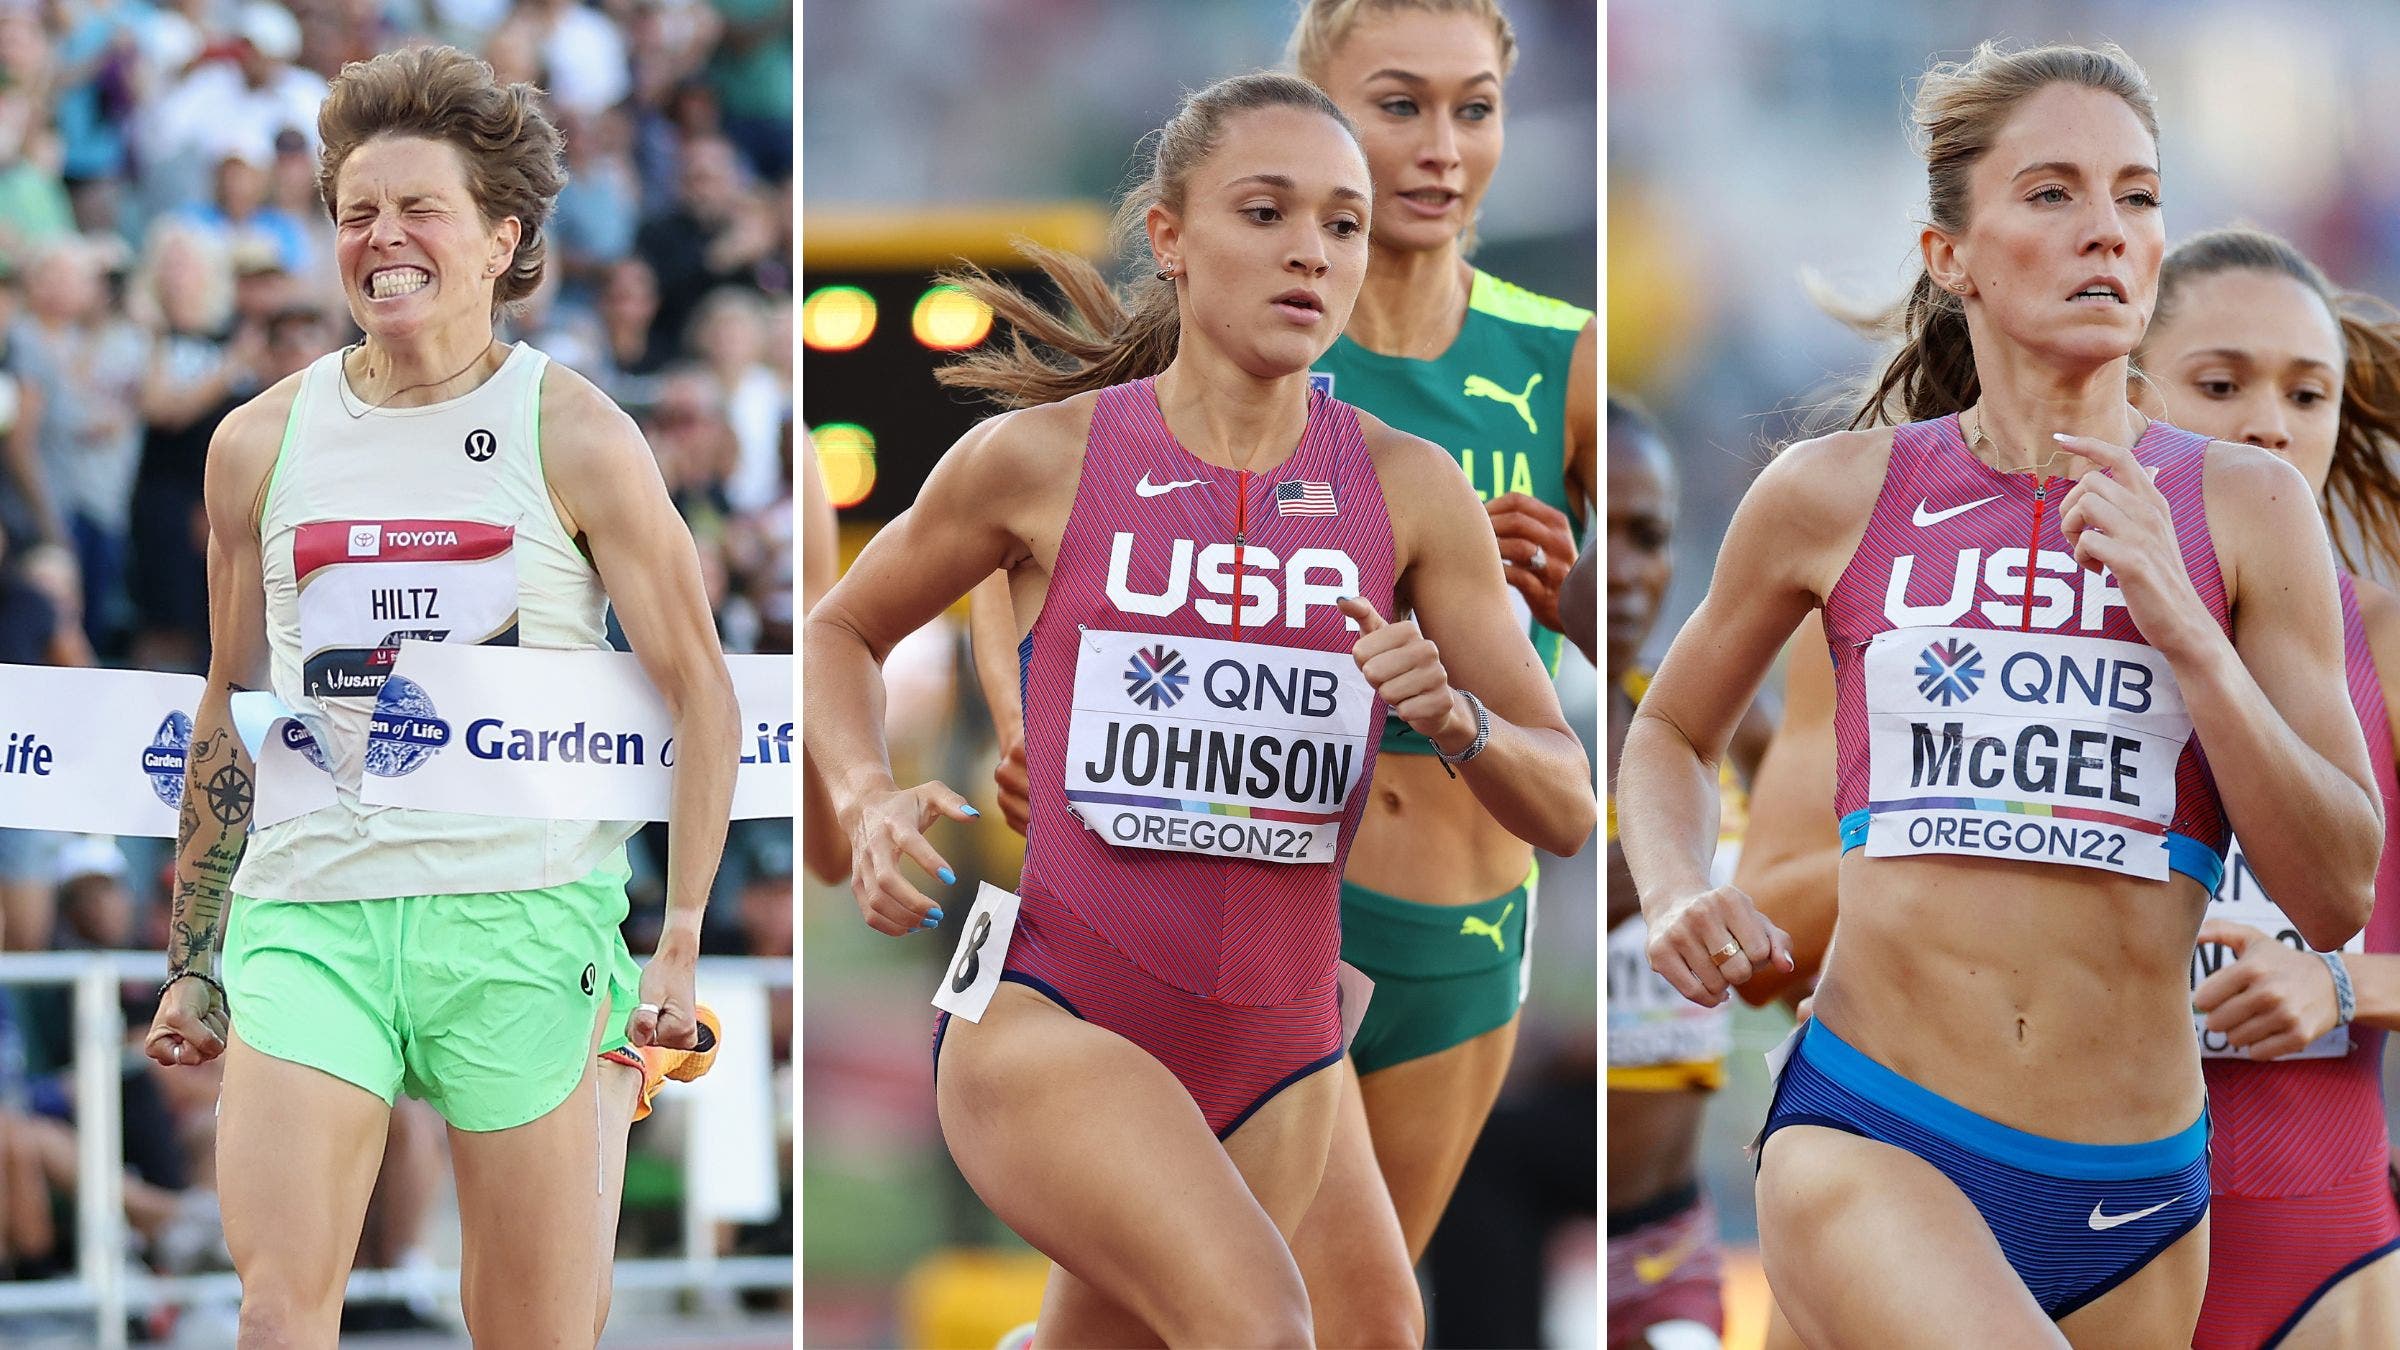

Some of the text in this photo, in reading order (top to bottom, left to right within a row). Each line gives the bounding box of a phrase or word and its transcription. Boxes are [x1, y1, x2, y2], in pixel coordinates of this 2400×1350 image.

[386, 531, 458, 547] TOYOTA
[371, 588, 440, 620] HILTZ
[1105, 531, 1361, 632] USA
[343, 675, 387, 688] USATF
[1203, 659, 1339, 717] QNB
[2000, 651, 2153, 714] QNB
[392, 719, 413, 740] of
[412, 723, 443, 740] Life
[464, 717, 644, 765] Garden
[740, 722, 793, 764] if
[0, 732, 53, 776] ife
[144, 752, 183, 768] Garden
[1085, 721, 1353, 805] JOHNSON
[1910, 721, 2142, 807] McGEE
[1112, 812, 1313, 859] OREGON22
[1908, 815, 2127, 866] OREGON22
[951, 911, 992, 993] 8
